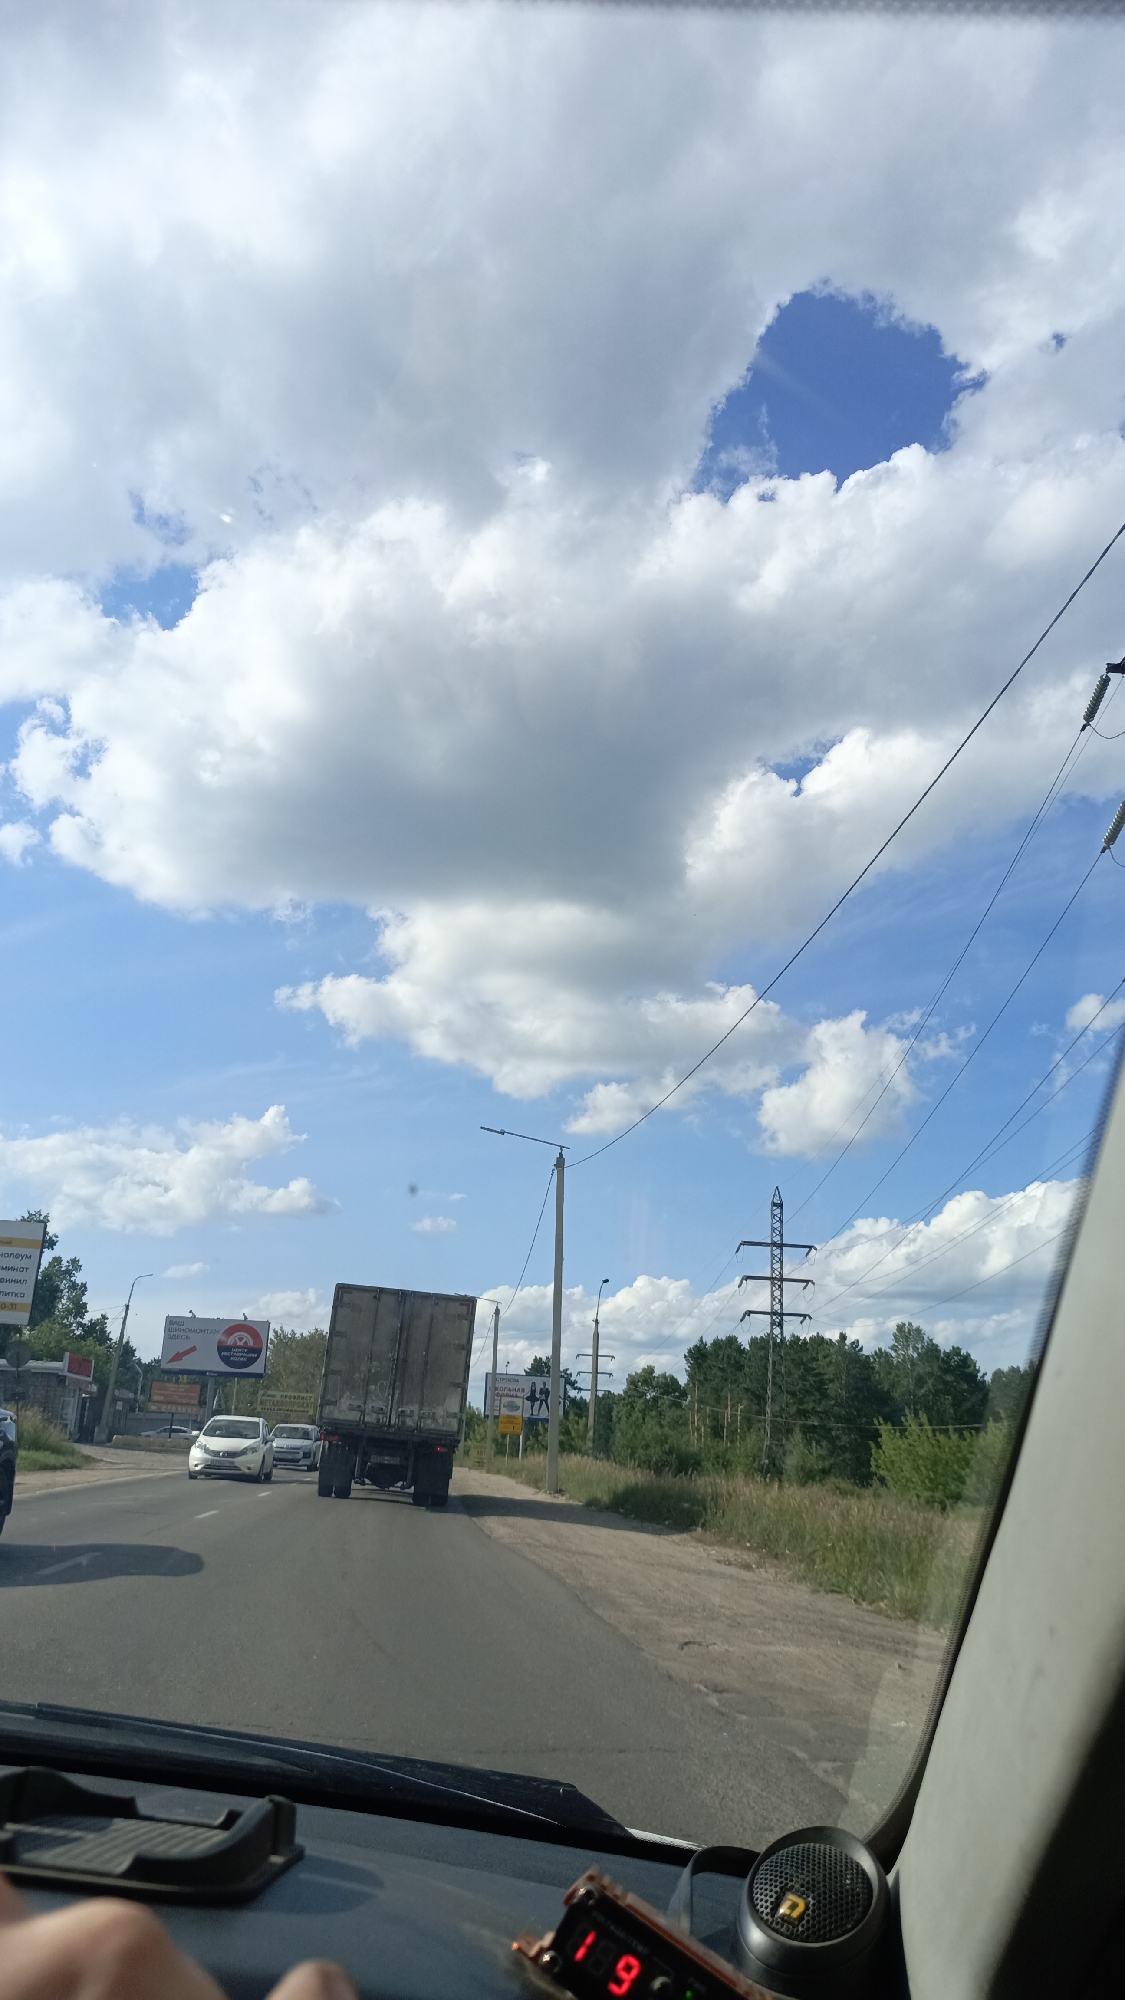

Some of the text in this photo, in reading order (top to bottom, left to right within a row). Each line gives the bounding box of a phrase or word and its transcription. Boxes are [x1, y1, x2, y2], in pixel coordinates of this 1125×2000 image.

[0, 1265, 30, 1273] минат
[169, 1319, 185, 1327] ВАШ
[168, 1327, 221, 1335] ШИНОМОНТАЖ
[168, 1333, 191, 1341] ЗДЕСЬ
[279, 1394, 313, 1402] ПРОФЛИСТ
